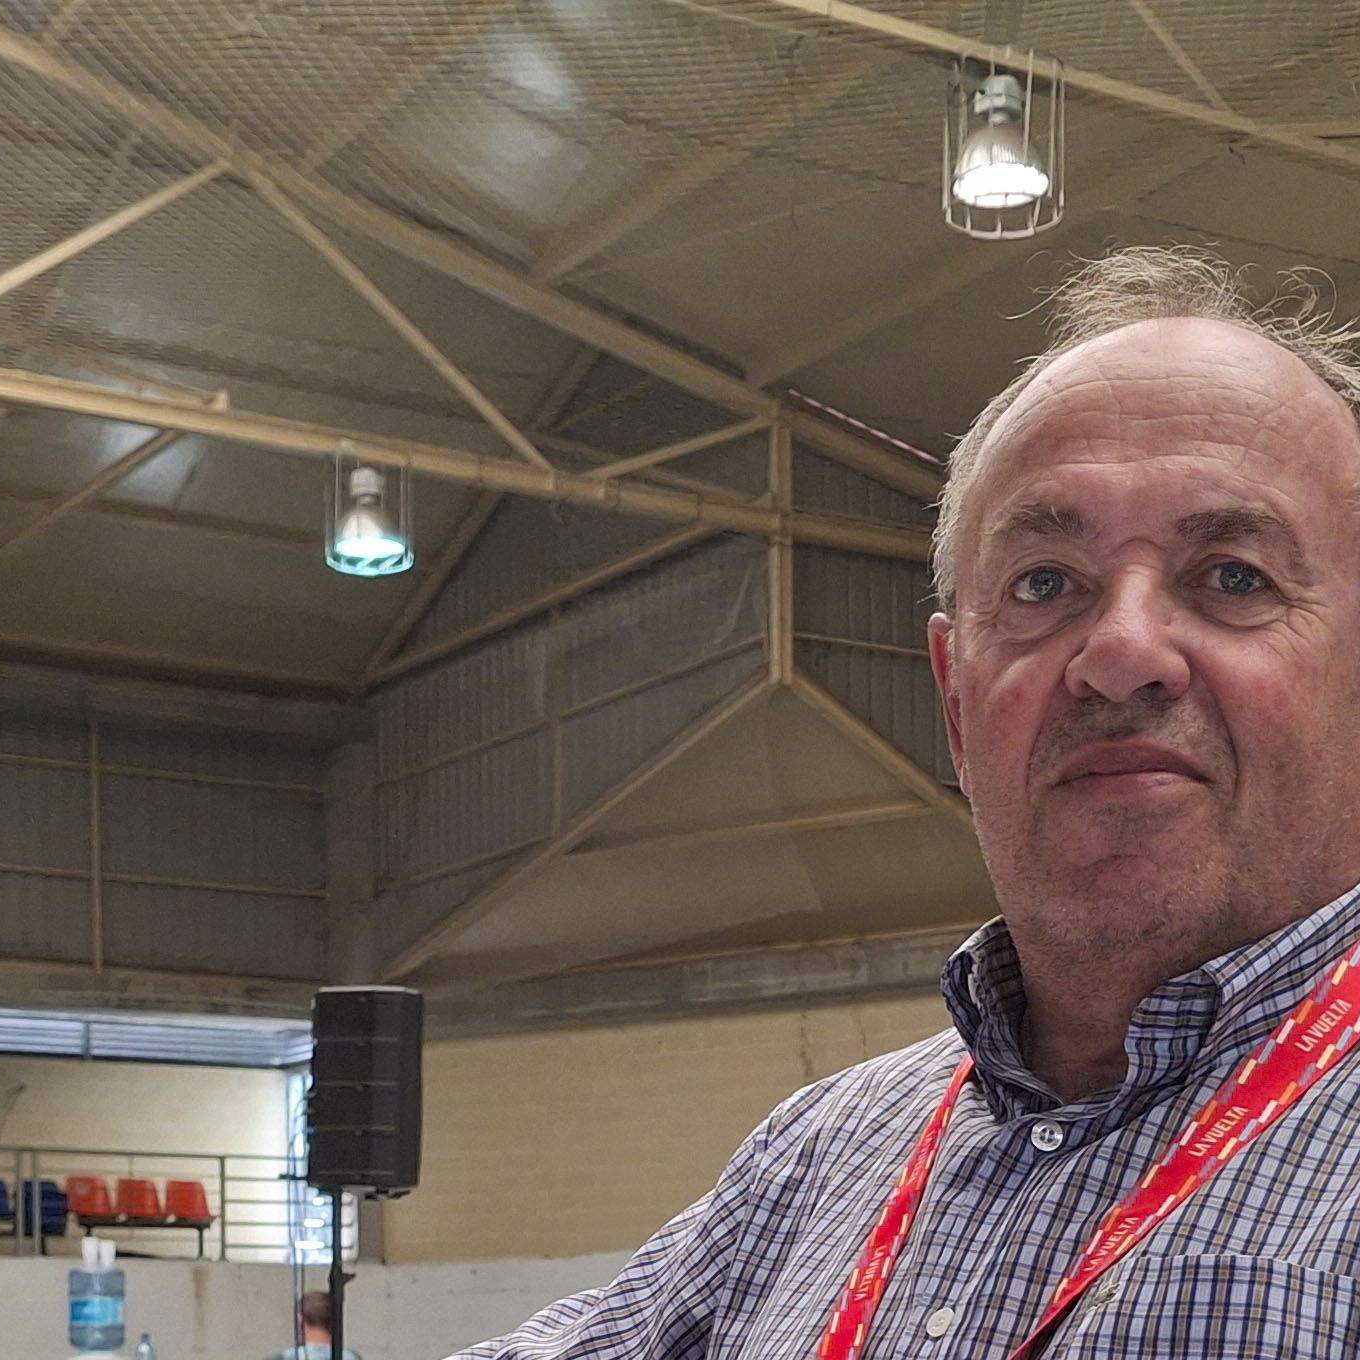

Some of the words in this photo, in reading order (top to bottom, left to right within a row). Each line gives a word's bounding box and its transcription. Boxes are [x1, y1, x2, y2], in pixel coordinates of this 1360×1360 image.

[1293, 1034, 1319, 1053] LA
[1306, 998, 1353, 1039] VUELTA
[1187, 1142, 1212, 1157] LA
[1200, 1105, 1249, 1143] VUELTA
[1083, 1258, 1103, 1271] LA
[1094, 1217, 1140, 1257] VUELTA
